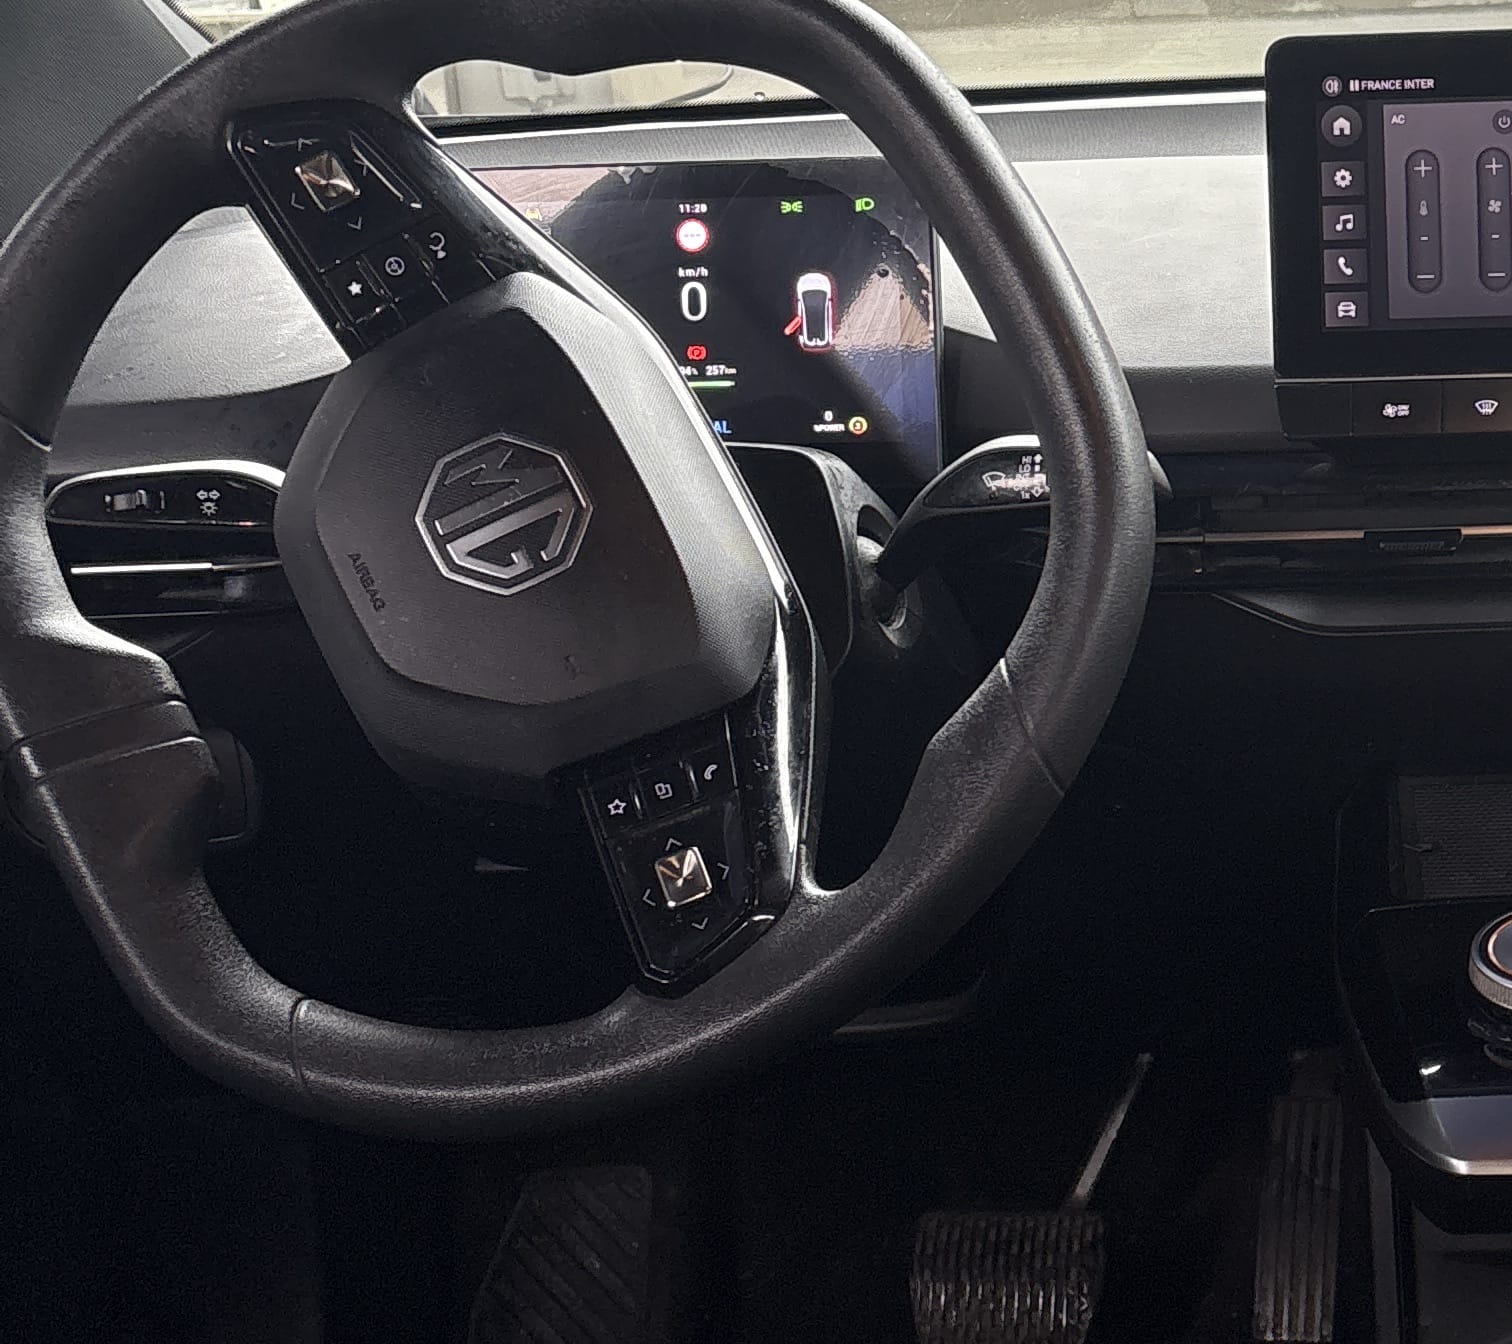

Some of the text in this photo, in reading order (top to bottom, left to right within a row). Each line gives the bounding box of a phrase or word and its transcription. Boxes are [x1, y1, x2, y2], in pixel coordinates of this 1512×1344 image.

[1361, 79, 1434, 90] FRANCE INTER
[1391, 114, 1405, 124] AC
[678, 203, 708, 214] 11:20
[678, 267, 708, 277] km/h
[681, 281, 707, 322] 0
[824, 410, 833, 422] 0
[435, 444, 576, 580] MG
[348, 552, 386, 613] AIRBAG
